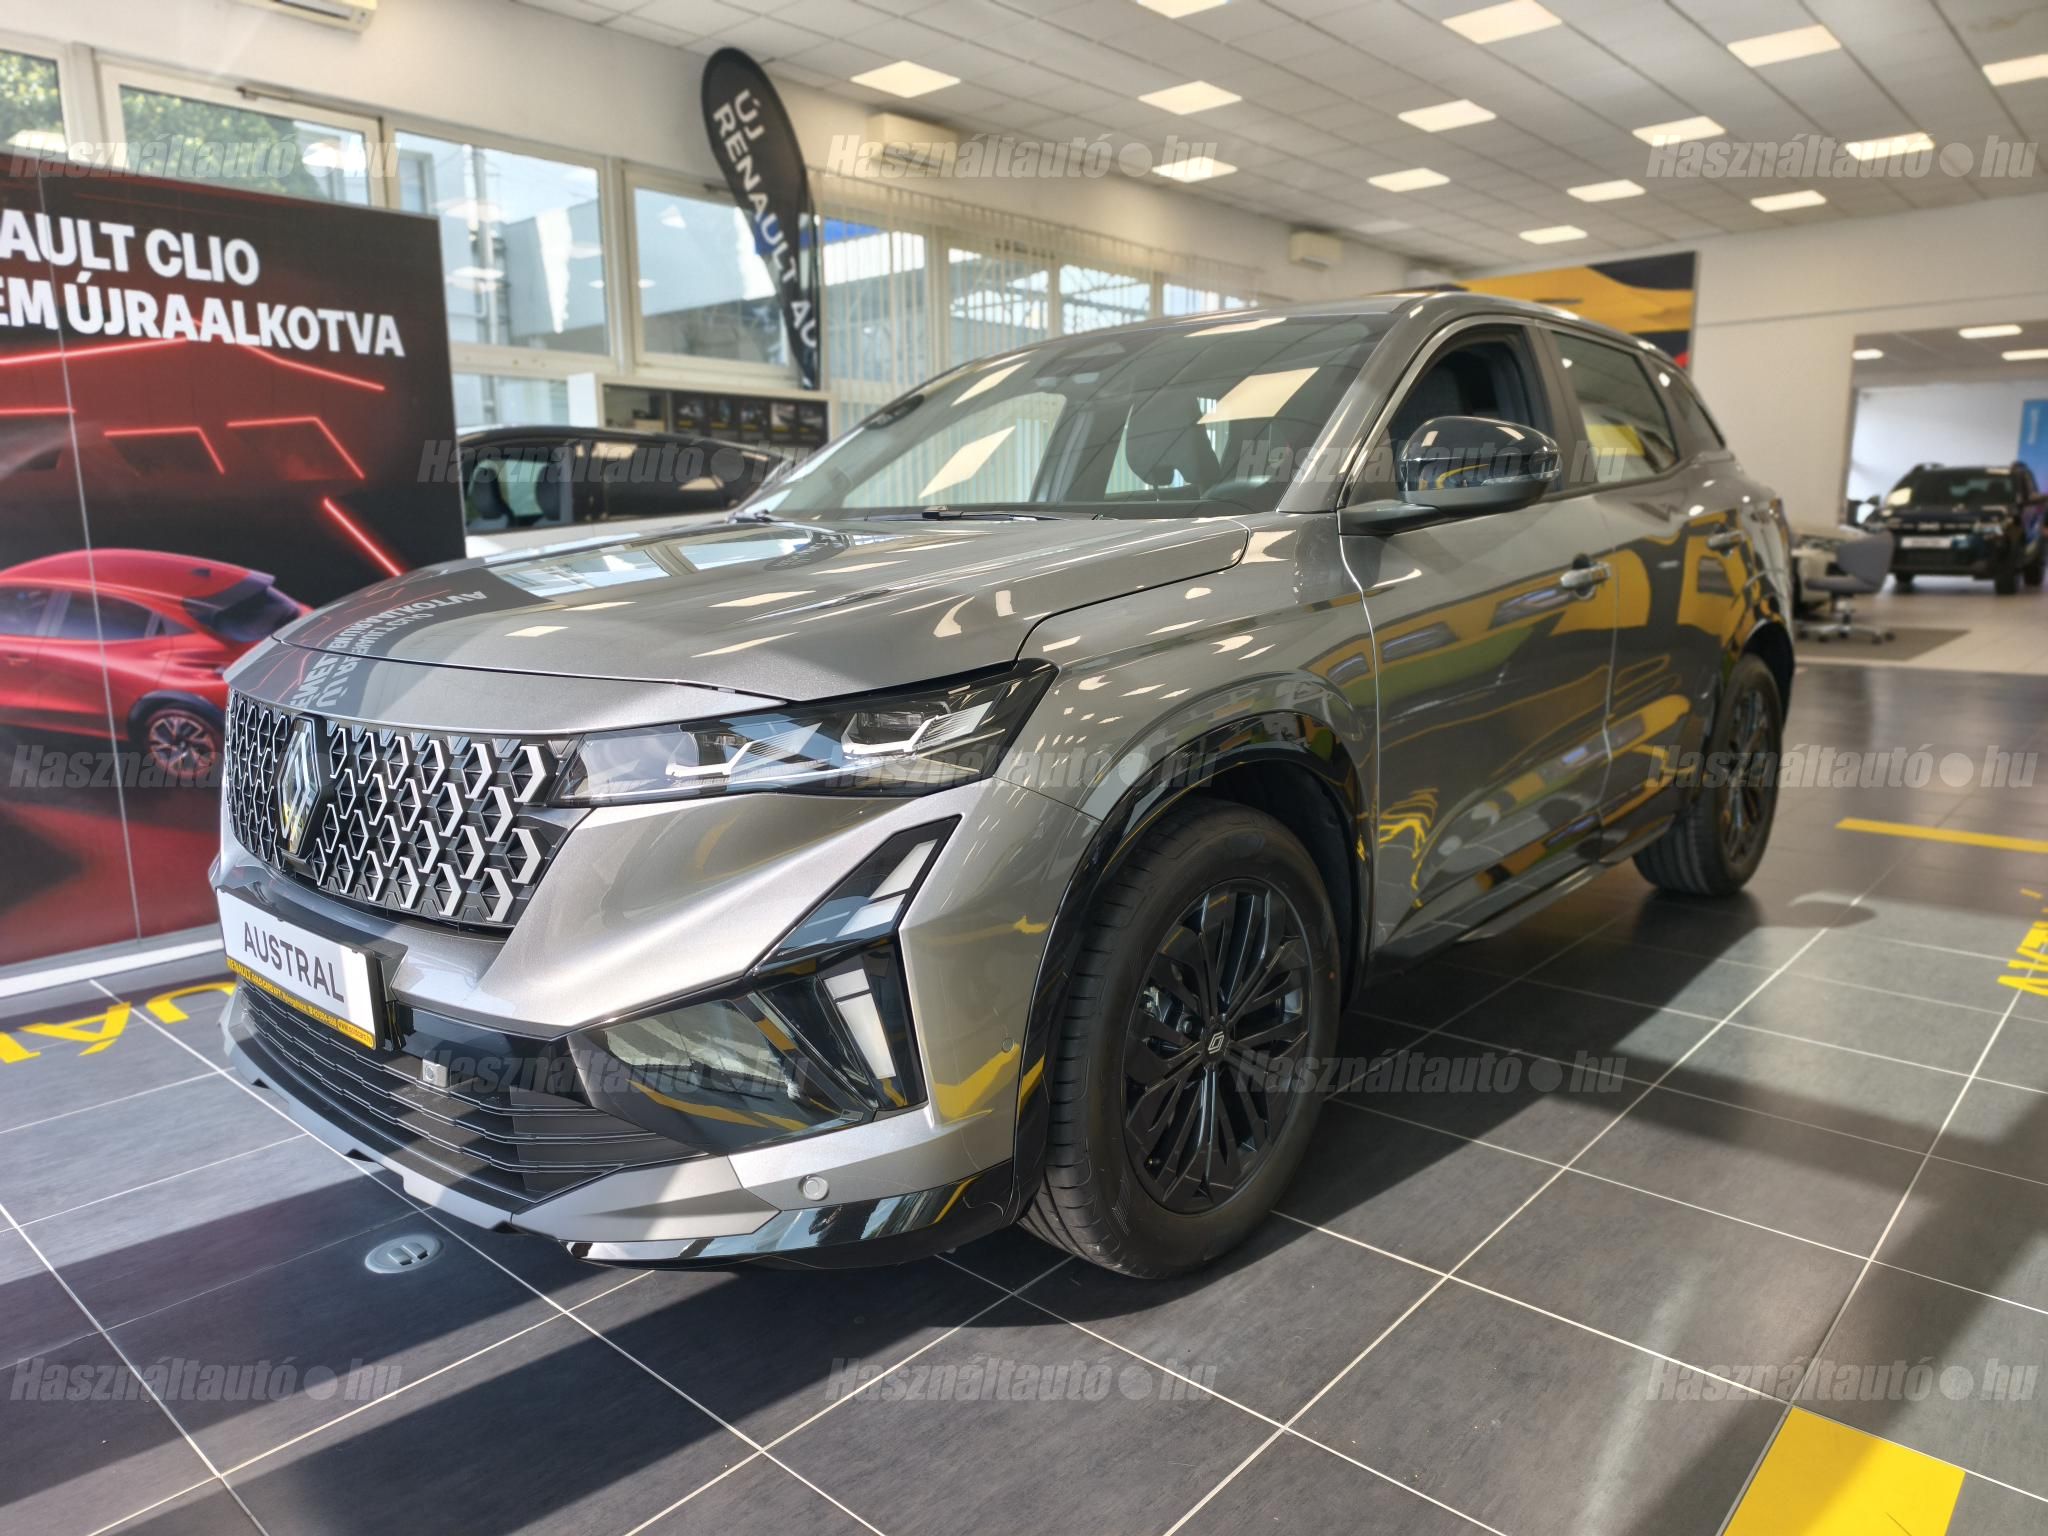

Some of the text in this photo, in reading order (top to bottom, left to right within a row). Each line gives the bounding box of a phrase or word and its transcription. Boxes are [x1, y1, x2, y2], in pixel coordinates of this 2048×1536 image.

[734, 89, 765, 139] ÚJ
[713, 102, 797, 284] RENAULT
[145, 228, 260, 286] CLIO
[64, 271, 405, 357] ÚJRAALKOTVA
[244, 921, 344, 1003] AUSTRAL
